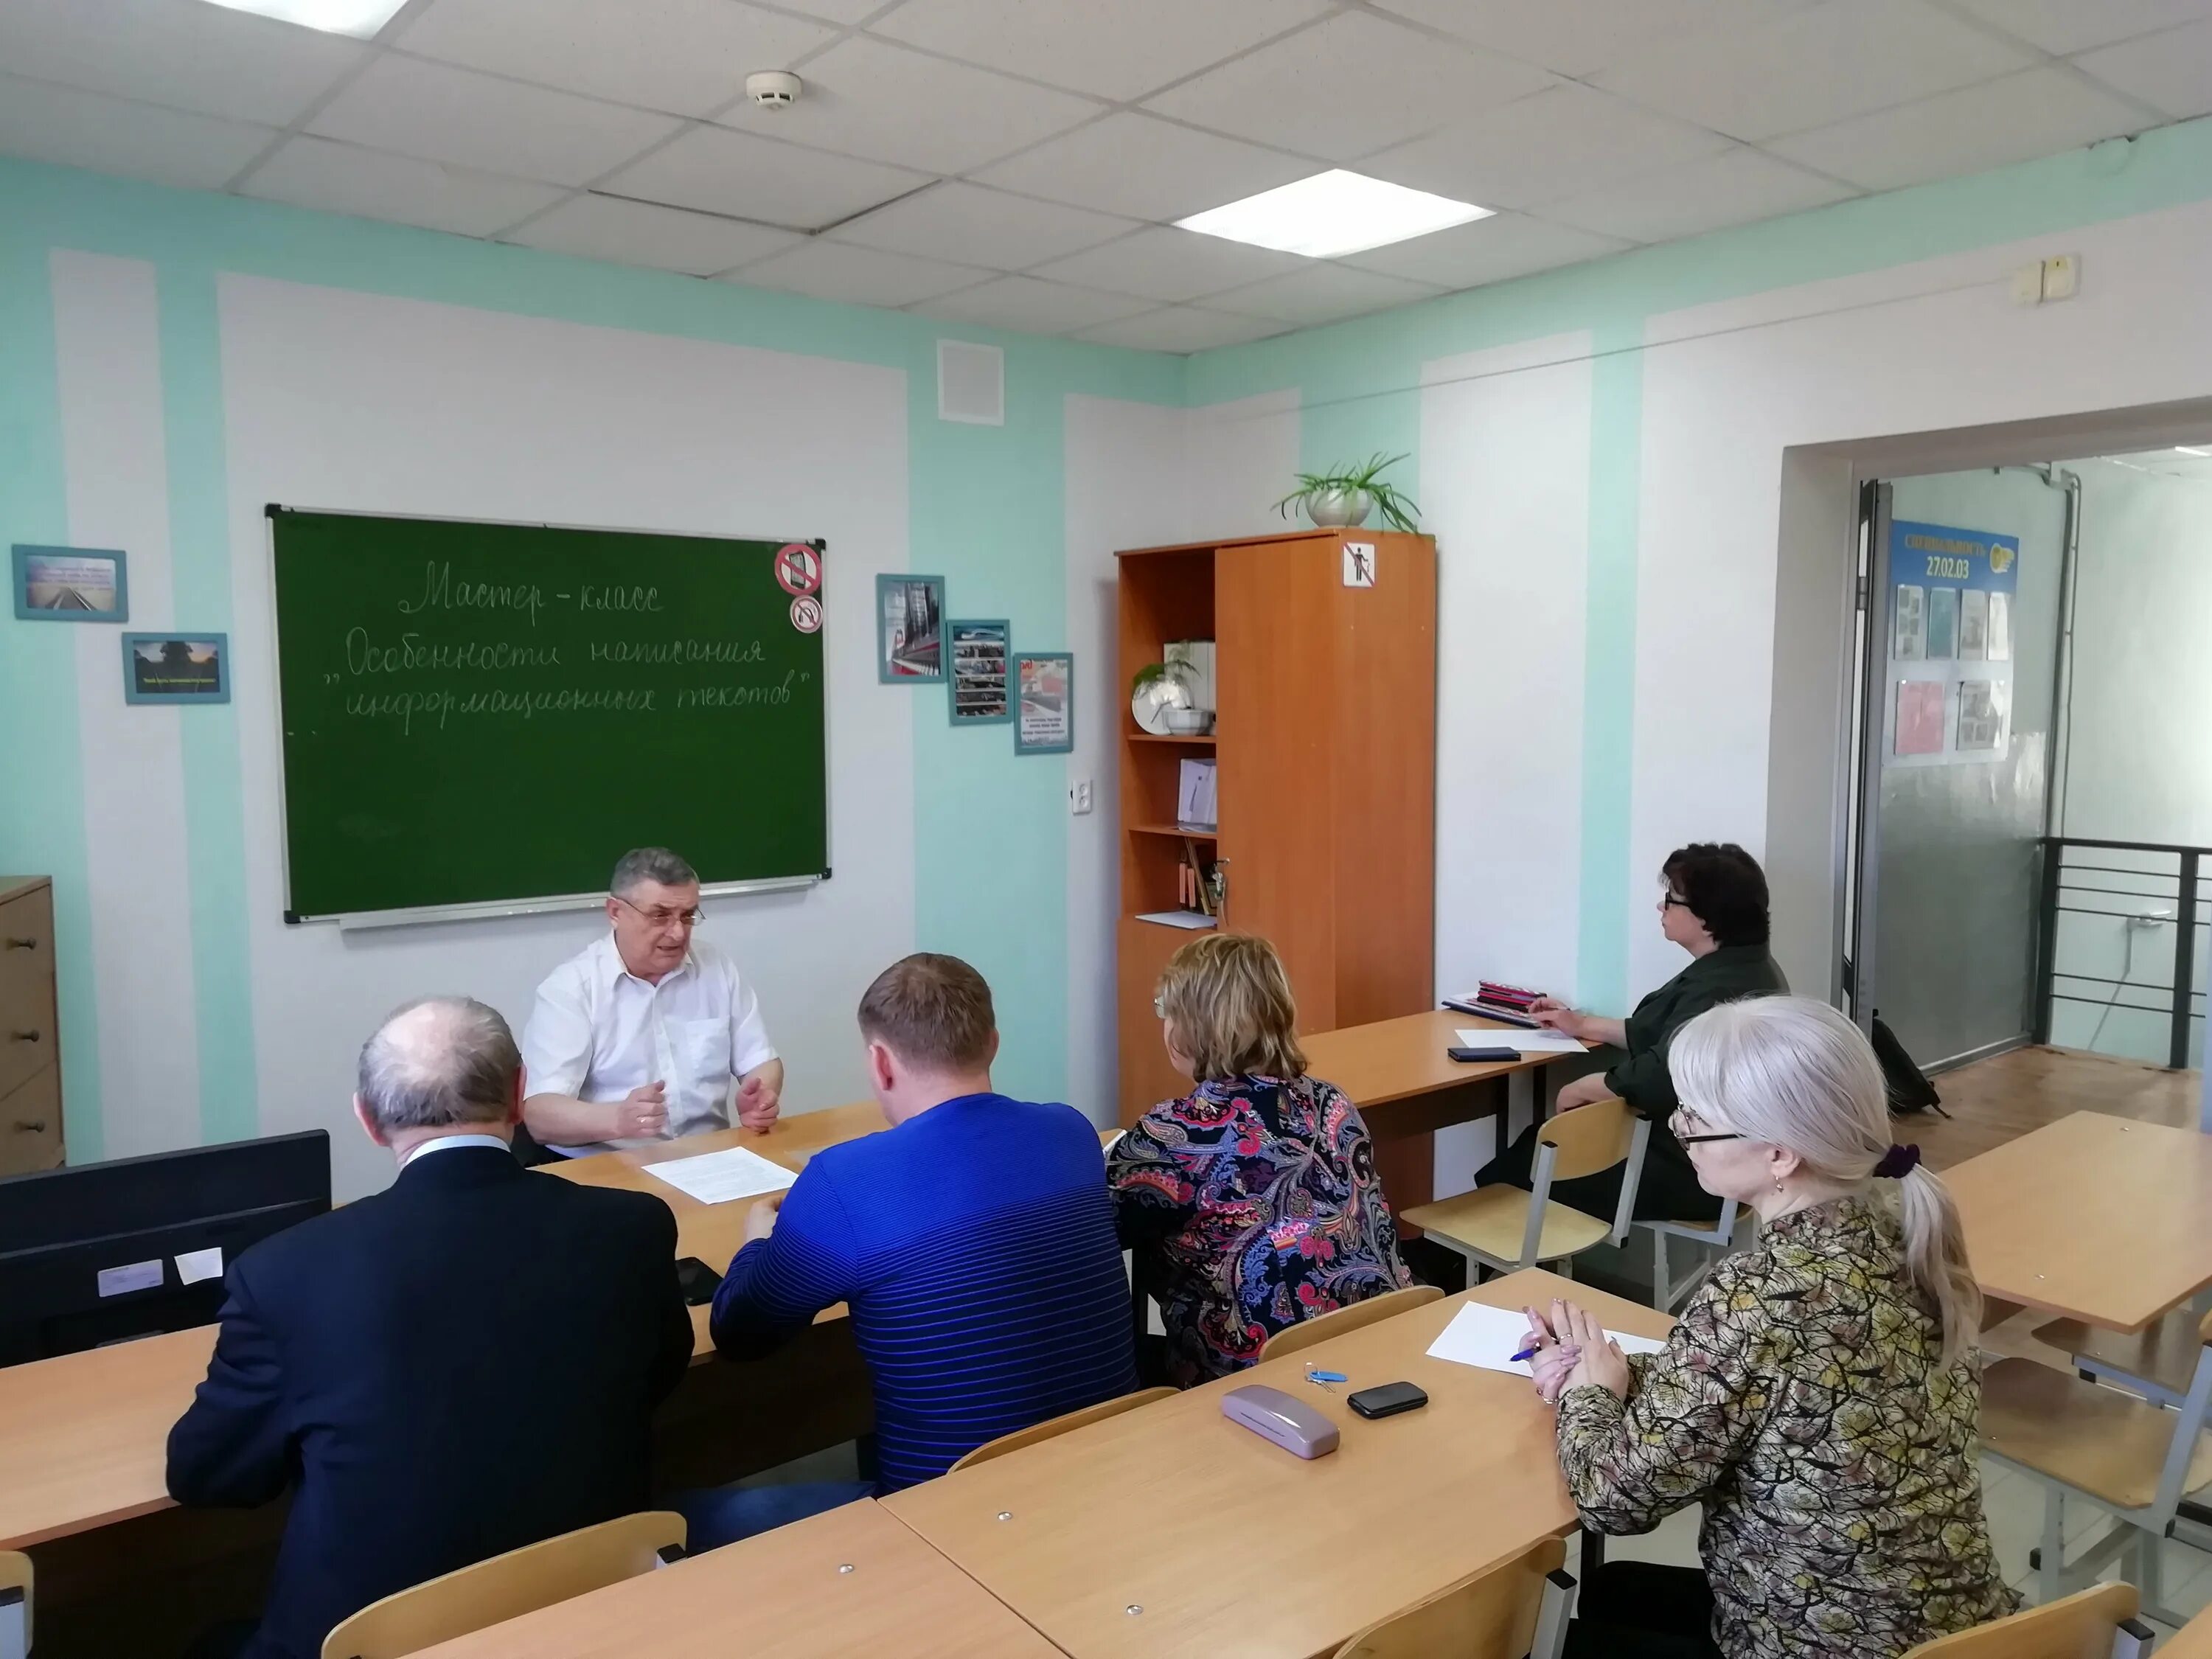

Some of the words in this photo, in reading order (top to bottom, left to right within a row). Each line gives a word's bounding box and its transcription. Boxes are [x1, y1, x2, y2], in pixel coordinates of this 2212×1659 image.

[1926, 555, 1969, 580] 27.02.03
[591, 639, 765, 664] написания
[347, 689, 655, 736] информационных
